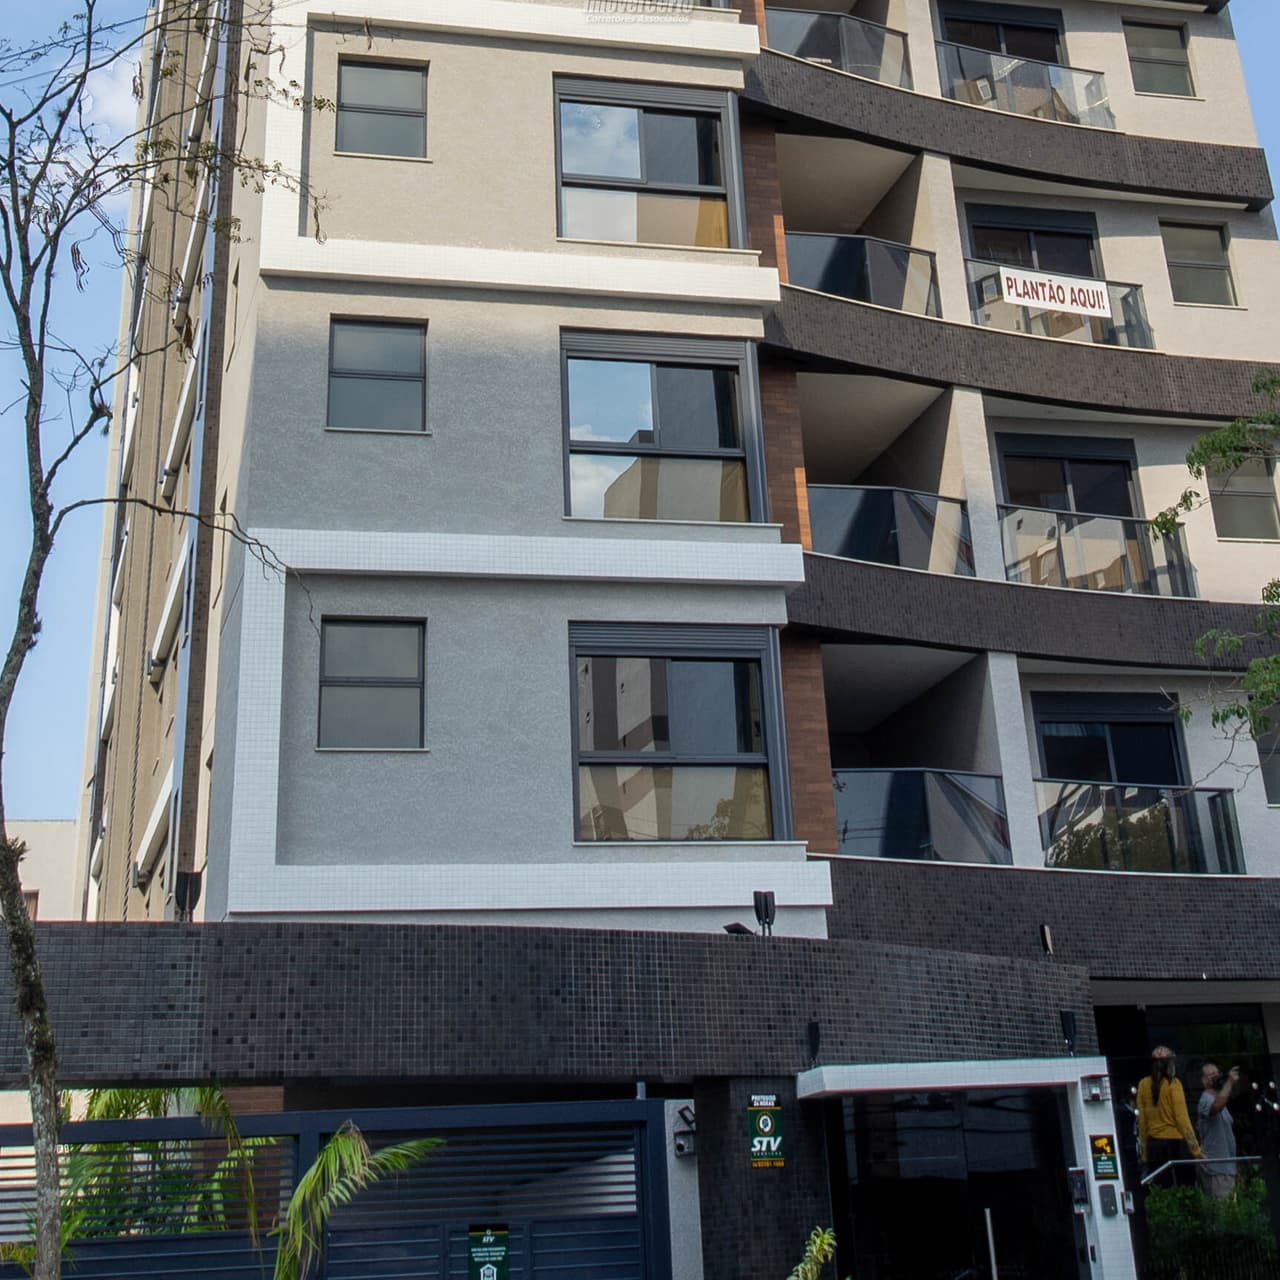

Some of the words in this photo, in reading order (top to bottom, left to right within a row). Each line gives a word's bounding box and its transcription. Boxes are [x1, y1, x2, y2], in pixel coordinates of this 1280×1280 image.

[1005, 276, 1066, 305] PLANTÃO
[1070, 287, 1105, 310] AQUI!
[751, 1135, 782, 1152] STV
